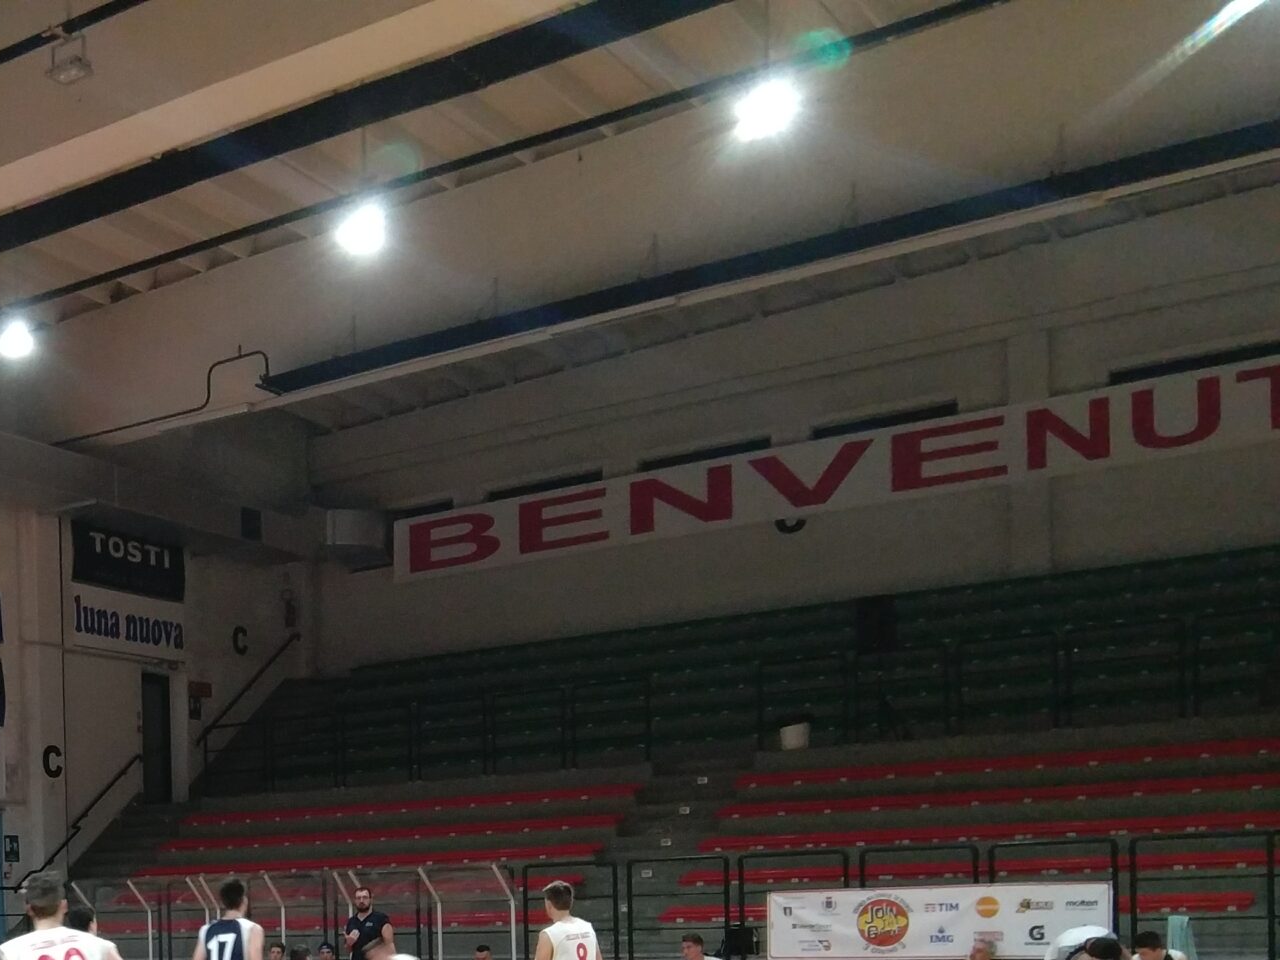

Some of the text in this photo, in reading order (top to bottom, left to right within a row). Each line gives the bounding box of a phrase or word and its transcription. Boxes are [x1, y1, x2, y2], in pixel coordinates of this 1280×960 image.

[407, 364, 1280, 574] BENVENUT
[89, 531, 170, 569] TOSTI
[74, 594, 184, 650] luna nuova
[232, 626, 248, 655] C
[43, 745, 63, 778] C
[938, 903, 960, 912] TIM
